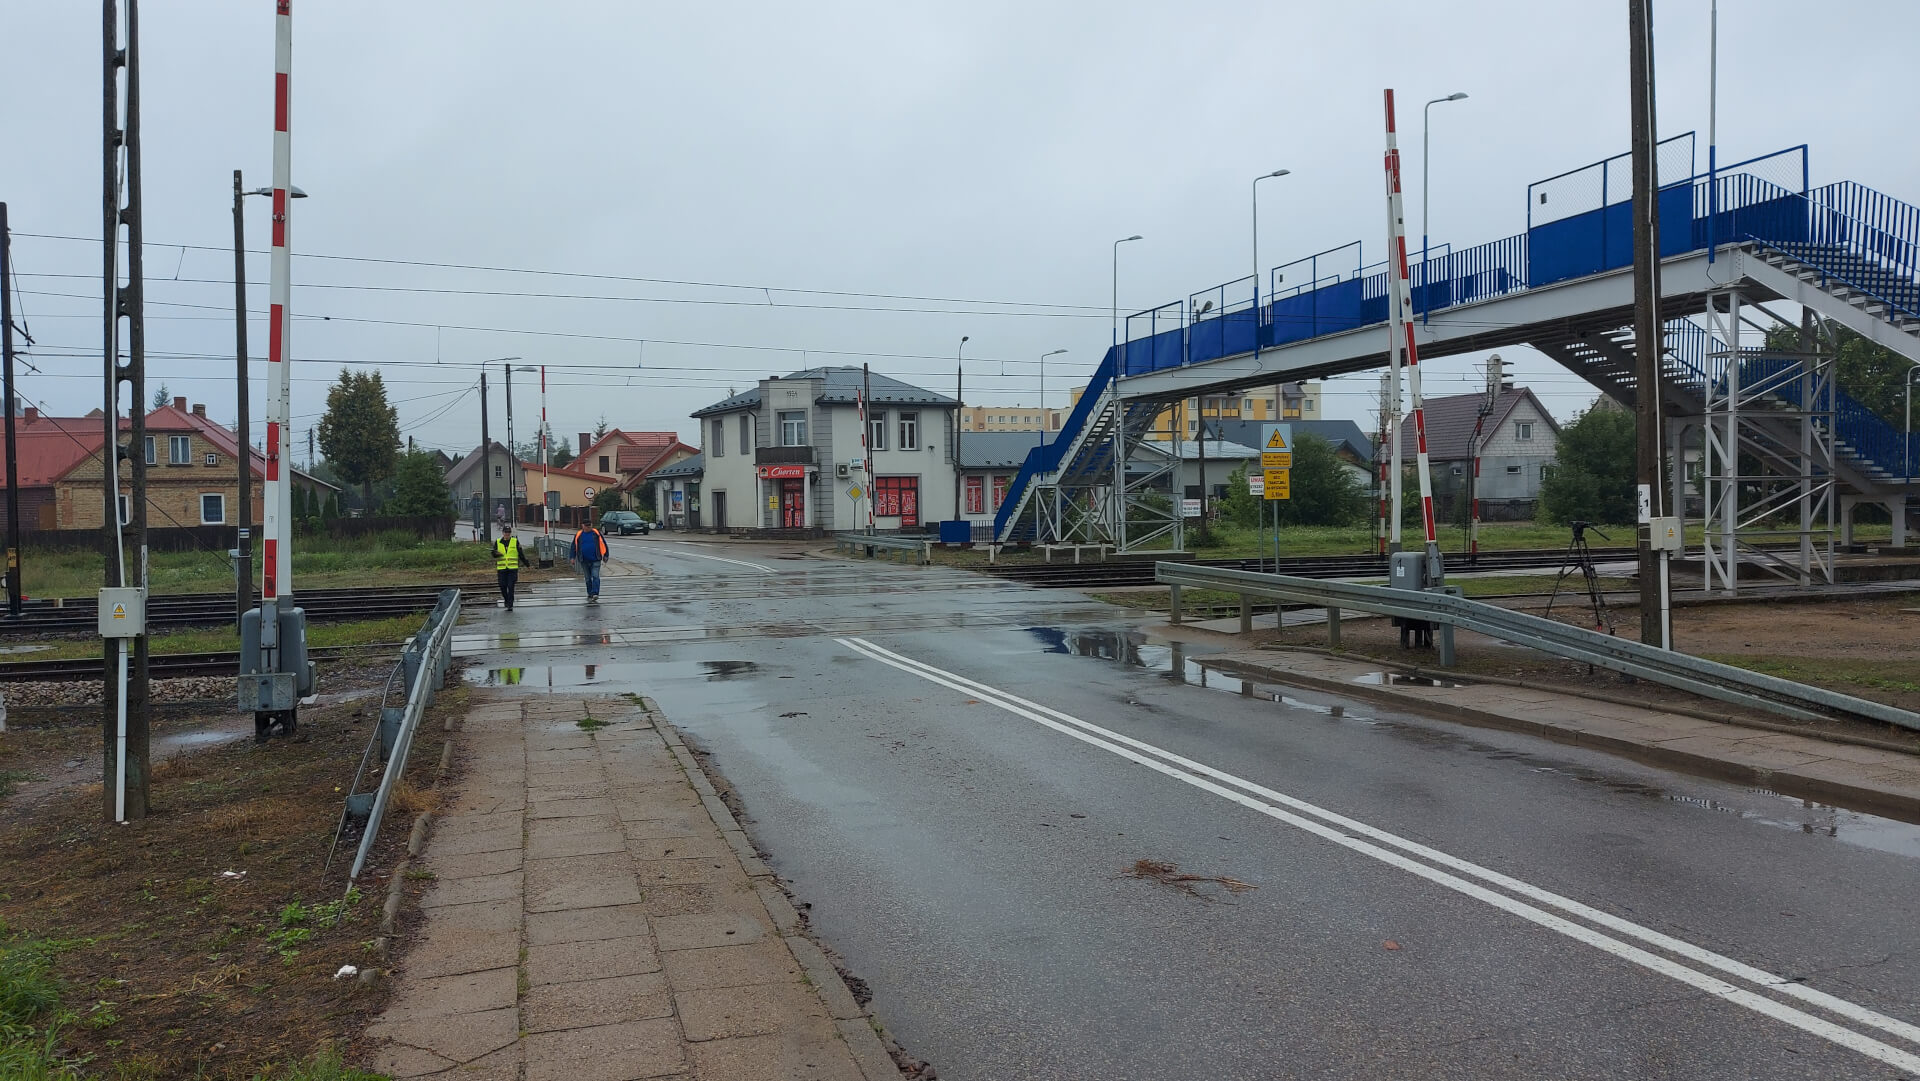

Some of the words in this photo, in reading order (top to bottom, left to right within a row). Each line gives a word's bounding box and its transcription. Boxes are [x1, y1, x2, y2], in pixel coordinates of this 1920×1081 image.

[771, 467, 800, 476] Chorten
[1643, 499, 1649, 507] 1
[1397, 558, 1402, 570] 1
